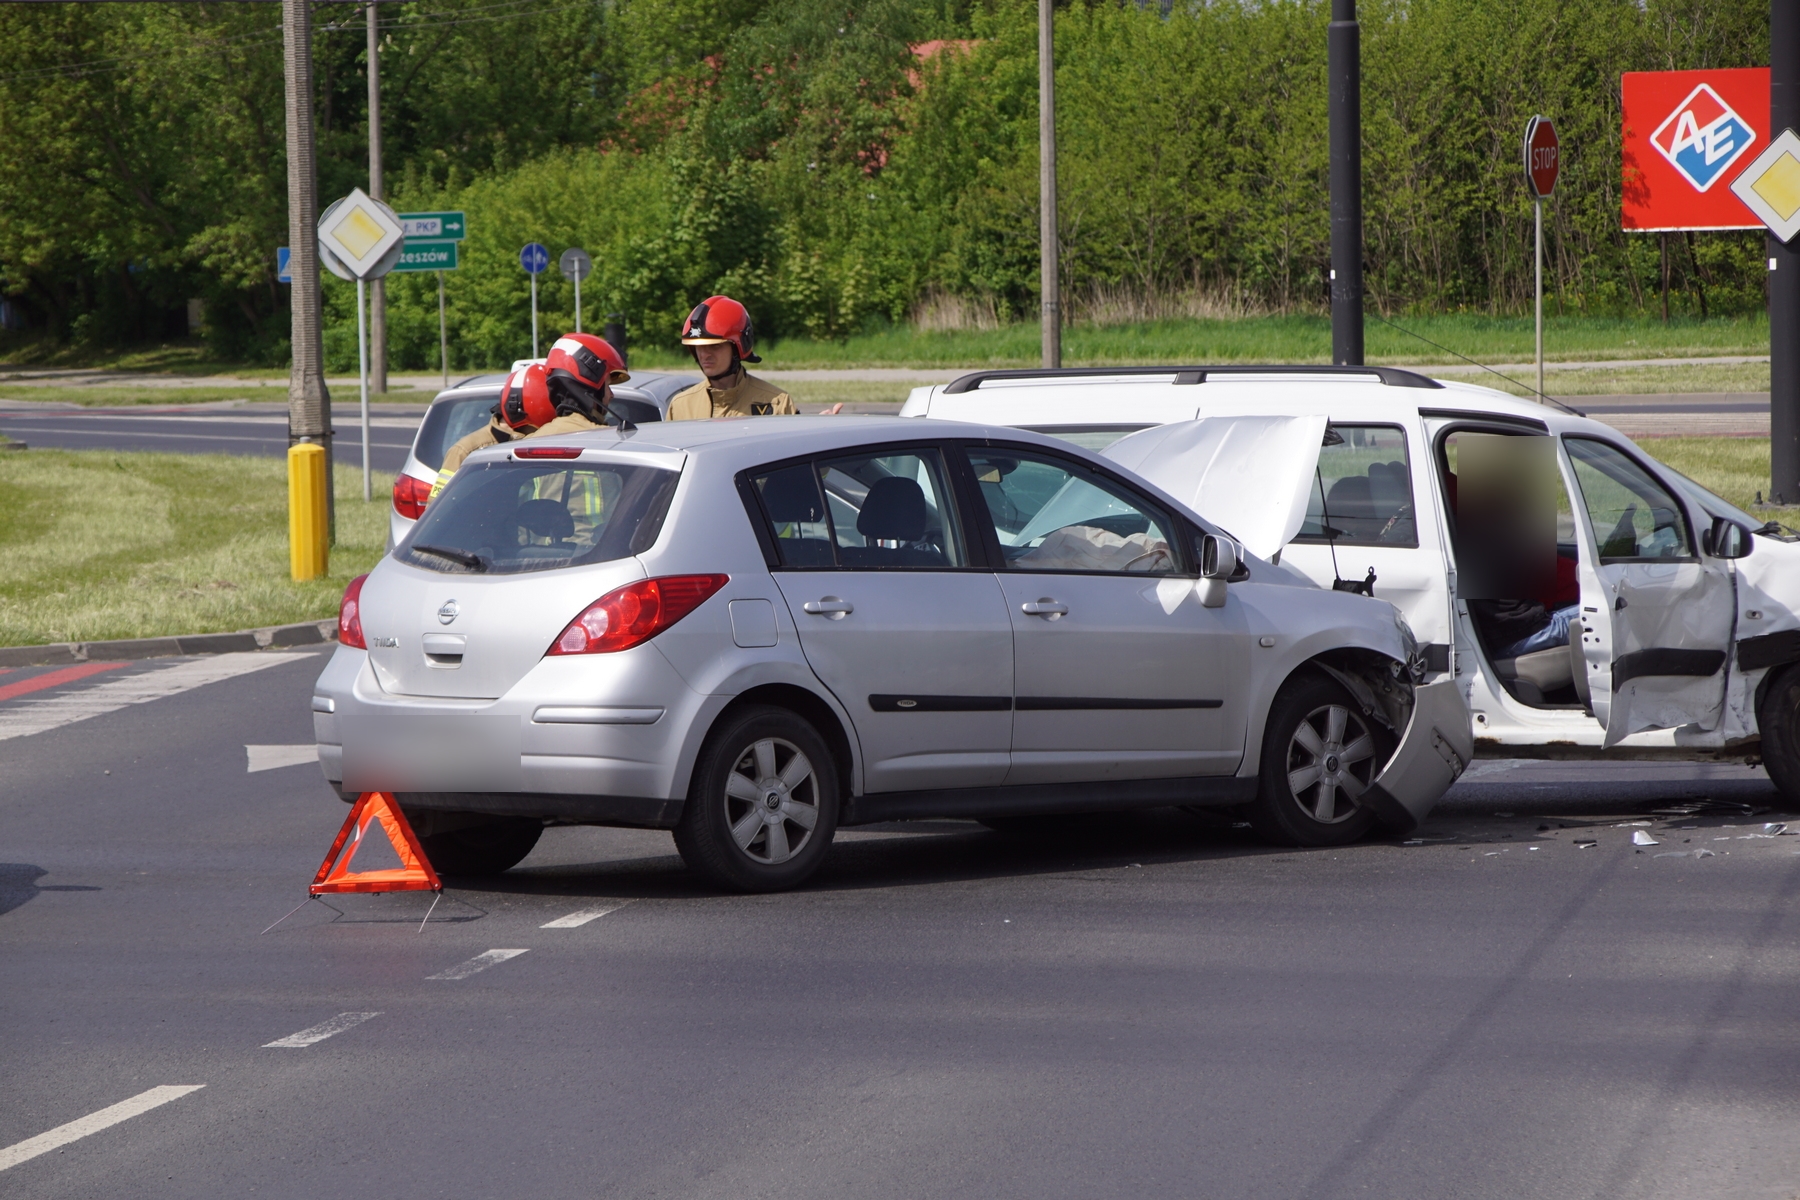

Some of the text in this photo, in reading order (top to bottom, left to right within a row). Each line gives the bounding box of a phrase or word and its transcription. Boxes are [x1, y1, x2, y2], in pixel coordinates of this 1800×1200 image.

[1534, 146, 1557, 170] STOP
[416, 222, 437, 233] PKP
[399, 248, 448, 263] zeszów
